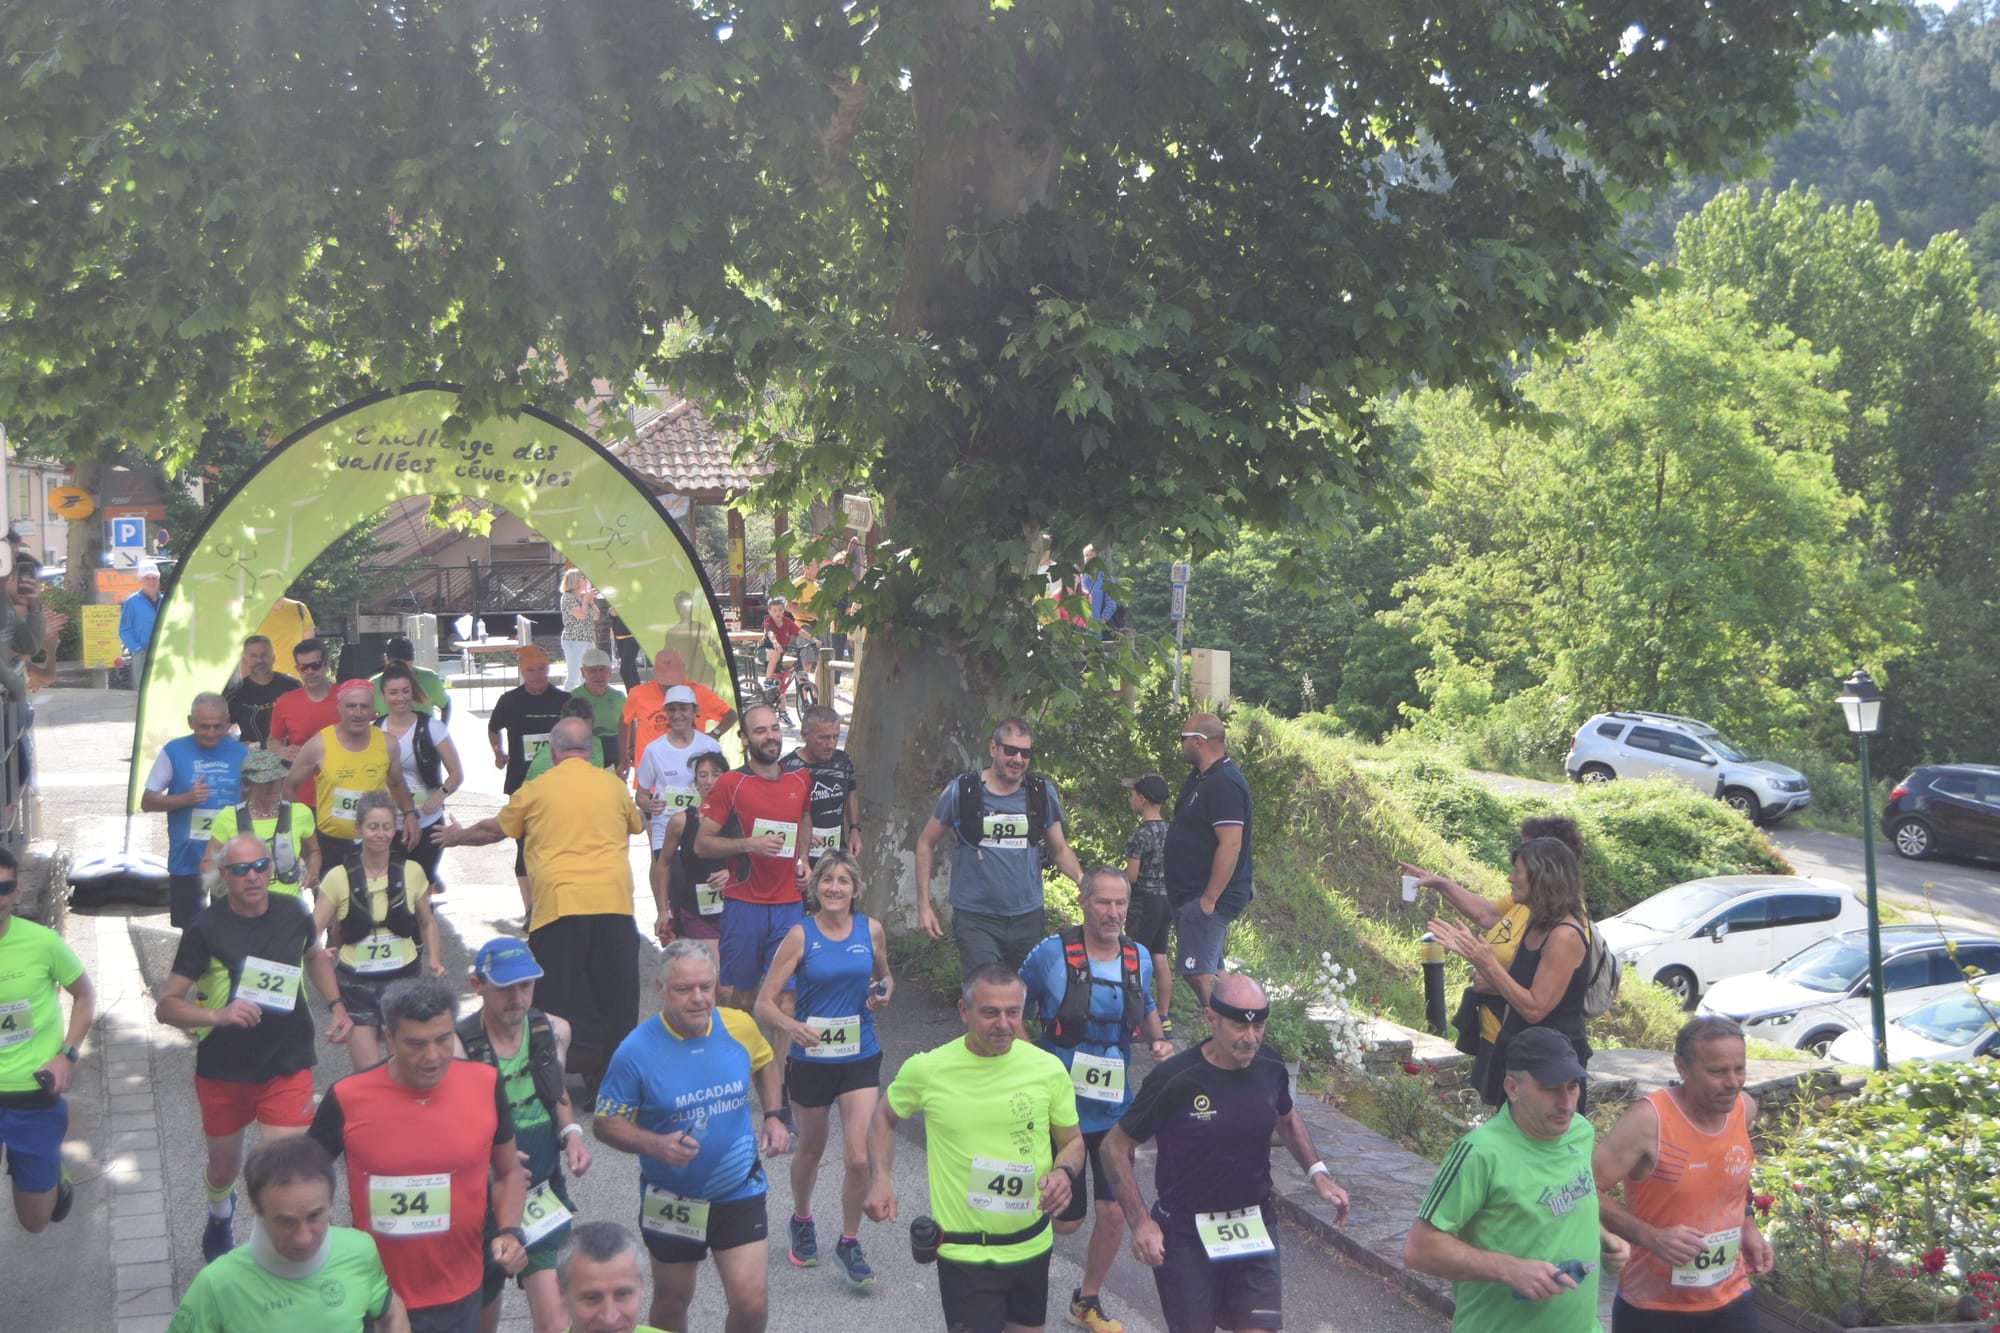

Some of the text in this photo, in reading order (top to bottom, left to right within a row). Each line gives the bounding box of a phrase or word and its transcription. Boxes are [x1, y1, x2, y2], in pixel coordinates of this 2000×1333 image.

[337, 451, 437, 474] vallées
[512, 443, 558, 462] des
[120, 523, 136, 543] P
[674, 795, 695, 807] 67
[993, 823, 1016, 837] 89
[367, 943, 392, 960] 73
[256, 972, 286, 993] 32
[819, 1027, 847, 1044] 44
[1085, 1067, 1112, 1087] 61
[675, 1080, 744, 1109] MACADAM
[670, 1104, 707, 1123] CLUB
[987, 1174, 1024, 1197] 49
[390, 1190, 429, 1216] 34
[659, 1203, 690, 1224] 45
[1216, 1222, 1249, 1242] 50
[1693, 1245, 1727, 1270] 64
